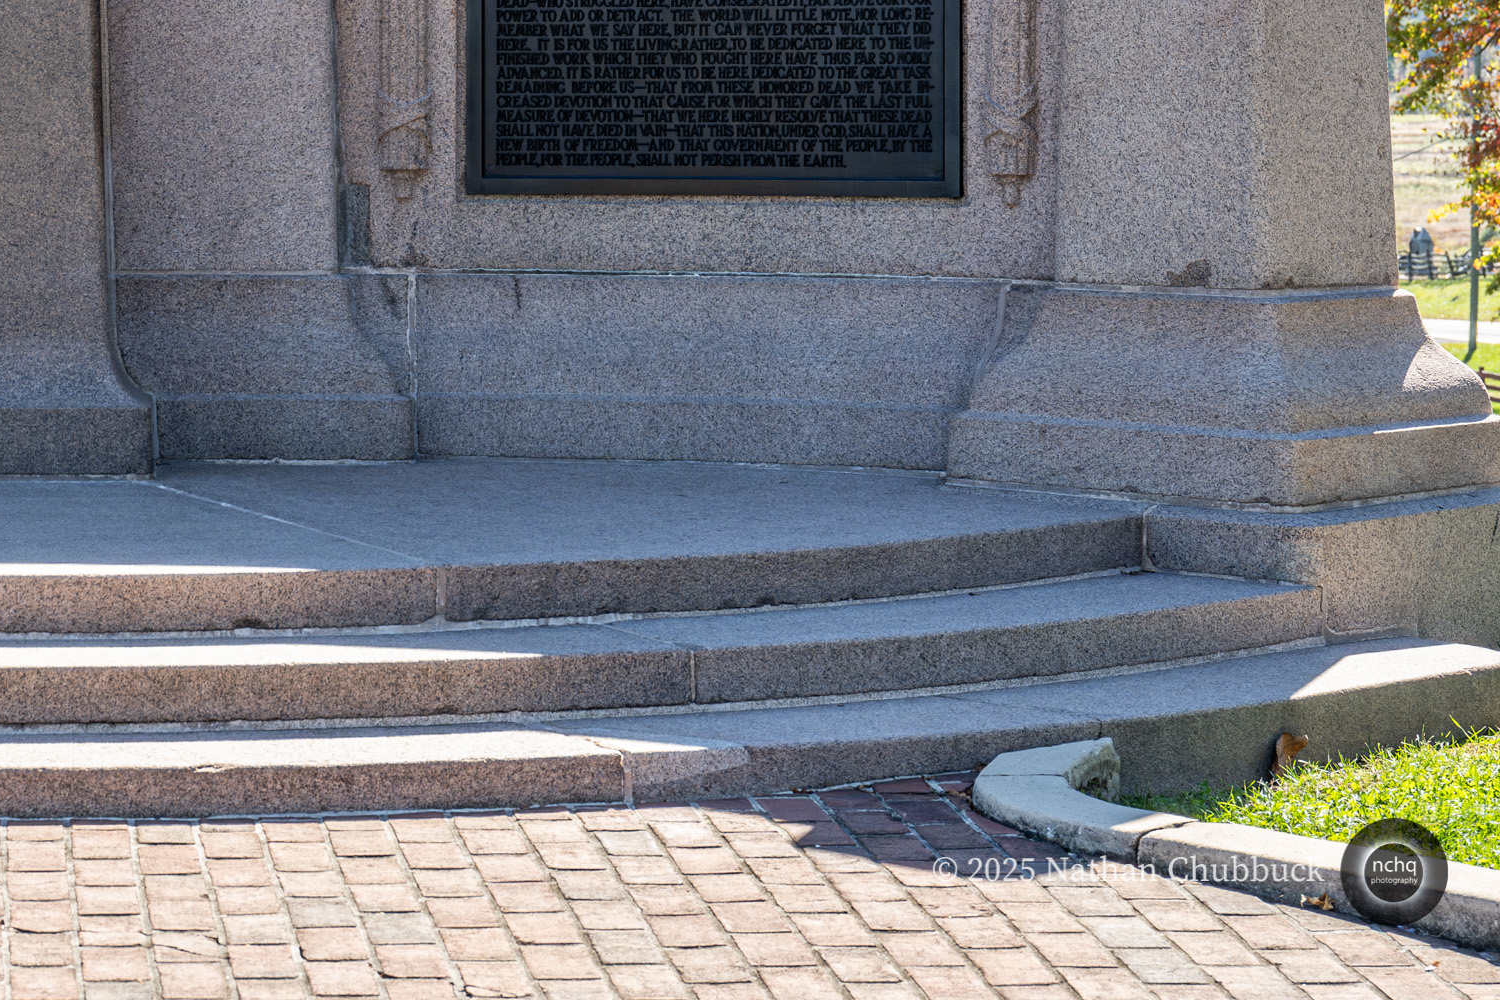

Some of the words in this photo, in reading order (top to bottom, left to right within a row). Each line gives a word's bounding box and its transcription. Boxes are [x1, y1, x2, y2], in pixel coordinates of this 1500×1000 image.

[496, 53, 550, 65] FINISHED
[553, 53, 588, 65] WORK
[593, 53, 632, 65] WHICH
[636, 53, 666, 65] THEY
[671, 53, 697, 65] WHO
[701, 53, 746, 65] FOUGHT
[750, 52, 782, 65] HERE
[786, 52, 817, 64] HAVE
[822, 52, 851, 64] THUS
[854, 52, 876, 64] FAR
[879, 52, 895, 64] SO
[496, 96, 552, 108] CREASED
[554, 96, 612, 108] DEVOTION
[615, 96, 630, 108] TO
[633, 96, 664, 108] THAT
[667, 96, 705, 108] CAUSE
[708, 96, 730, 108] FOR
[733, 96, 772, 108] WHICH
[775, 96, 806, 108] THEY
[810, 96, 841, 108] GAVE
[845, 96, 866, 108] THE
[870, 96, 902, 108] LAST
[905, 96, 932, 108] FULL
